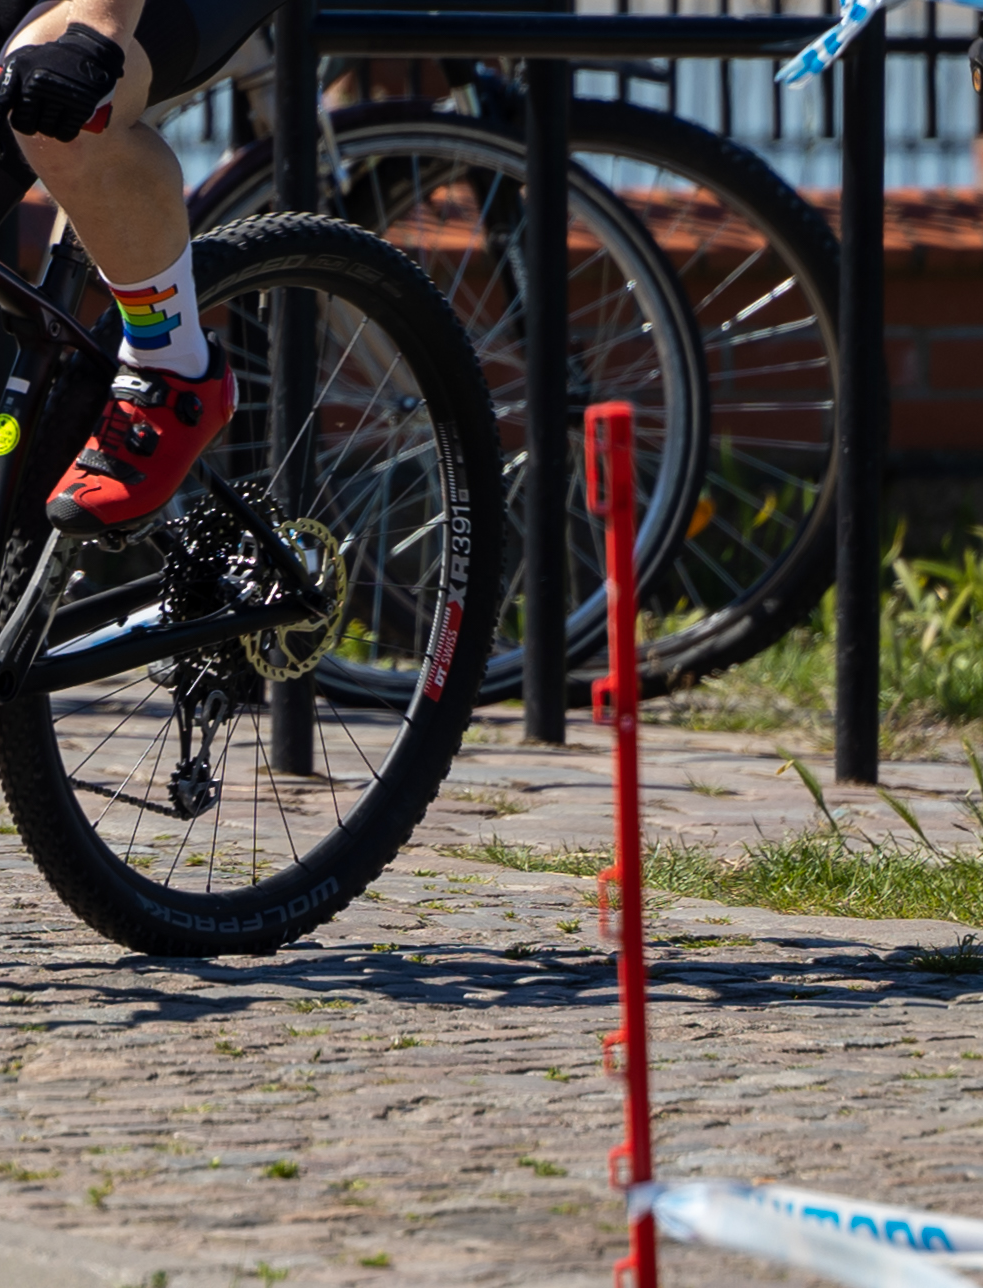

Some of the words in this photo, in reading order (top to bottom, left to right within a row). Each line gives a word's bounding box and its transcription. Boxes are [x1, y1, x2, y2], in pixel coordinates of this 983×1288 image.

[446, 500, 472, 611] XR391
[440, 629, 459, 667] SWISS
[434, 667, 450, 689] DT
[148, 875, 340, 934] WOLFPACK
